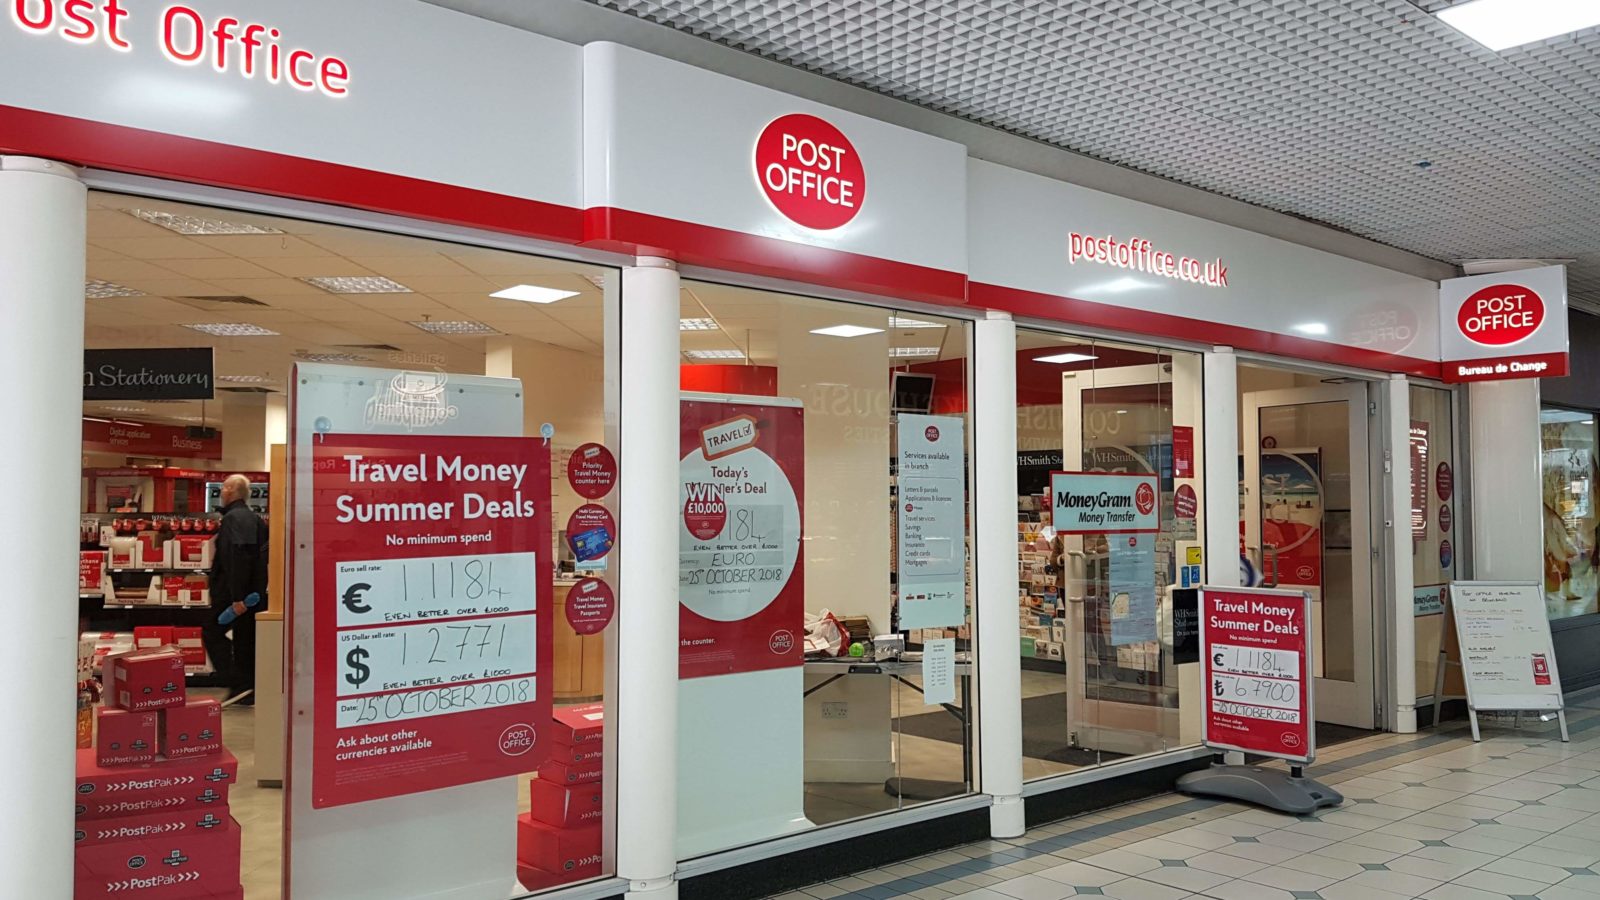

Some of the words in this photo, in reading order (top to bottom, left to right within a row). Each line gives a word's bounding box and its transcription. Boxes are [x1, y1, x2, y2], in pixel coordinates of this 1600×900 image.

[163, 5, 349, 95] Office
[782, 133, 846, 174] POST
[766, 163, 854, 208] OFFICE
[1069, 231, 1228, 287] postoffice.co.uk
[1477, 294, 1526, 315] POST
[1466, 311, 1534, 333] OFFICE
[100, 364, 208, 389] Stationery
[1458, 366, 1493, 376] Bureau
[1495, 363, 1508, 373] de
[1510, 361, 1548, 372] Change
[172, 435, 202, 449] Business
[708, 429, 743, 448] TRAVEL
[344, 454, 427, 482] Travel
[437, 455, 527, 489] Money
[582, 462, 603, 471] Priority
[592, 470, 611, 478] Money
[711, 466, 748, 481] Today's
[911, 462, 929, 470] branch
[685, 482, 725, 502] WIN
[725, 482, 742, 494] er's
[745, 482, 767, 494] Deal
[336, 495, 454, 523] Summer
[464, 491, 535, 519] Deals
[688, 502, 724, 515] £10,000
[1057, 492, 1131, 511] MoneyGram
[1079, 512, 1105, 525] Money
[1107, 511, 1135, 523] Transfer
[386, 534, 404, 546] No
[407, 534, 457, 545] minimum
[460, 530, 492, 546] spend
[712, 553, 755, 567] EURO
[402, 560, 512, 601] 1.1184
[706, 568, 756, 585] OCTOBER
[759, 568, 782, 581] 2018
[342, 583, 373, 614] €
[384, 612, 411, 622] EVEN
[418, 609, 450, 618] BETTER
[457, 607, 478, 615] OVER
[1214, 599, 1248, 614] Travel
[1252, 601, 1295, 621] Money
[1211, 616, 1260, 632] Summer
[1264, 620, 1299, 635] Deals
[352, 633, 370, 641] Dollar
[402, 624, 506, 665] 1.2771
[681, 638, 692, 646] the
[692, 638, 716, 646] counter.
[775, 634, 788, 642] POST
[345, 645, 370, 689] $
[1213, 653, 1224, 667] €
[383, 681, 407, 690] EVEN
[412, 677, 444, 686] BETTER
[451, 672, 475, 681] OVER
[483, 669, 511, 678] £1000
[385, 685, 477, 719] OCTOBER
[481, 680, 530, 706] 2018
[1230, 703, 1274, 720] OCTOBER
[1275, 710, 1298, 722] 2018
[336, 738, 356, 748] Ask
[360, 733, 388, 745] about
[391, 729, 418, 741] other
[503, 738, 531, 749] OFFICE
[508, 730, 528, 741] POST
[336, 746, 388, 761] currencies
[390, 738, 432, 753] available
[128, 778, 172, 790] PostPak
[121, 800, 164, 811] PostPak
[120, 825, 164, 838] PostPak
[130, 874, 176, 890] PostPak
